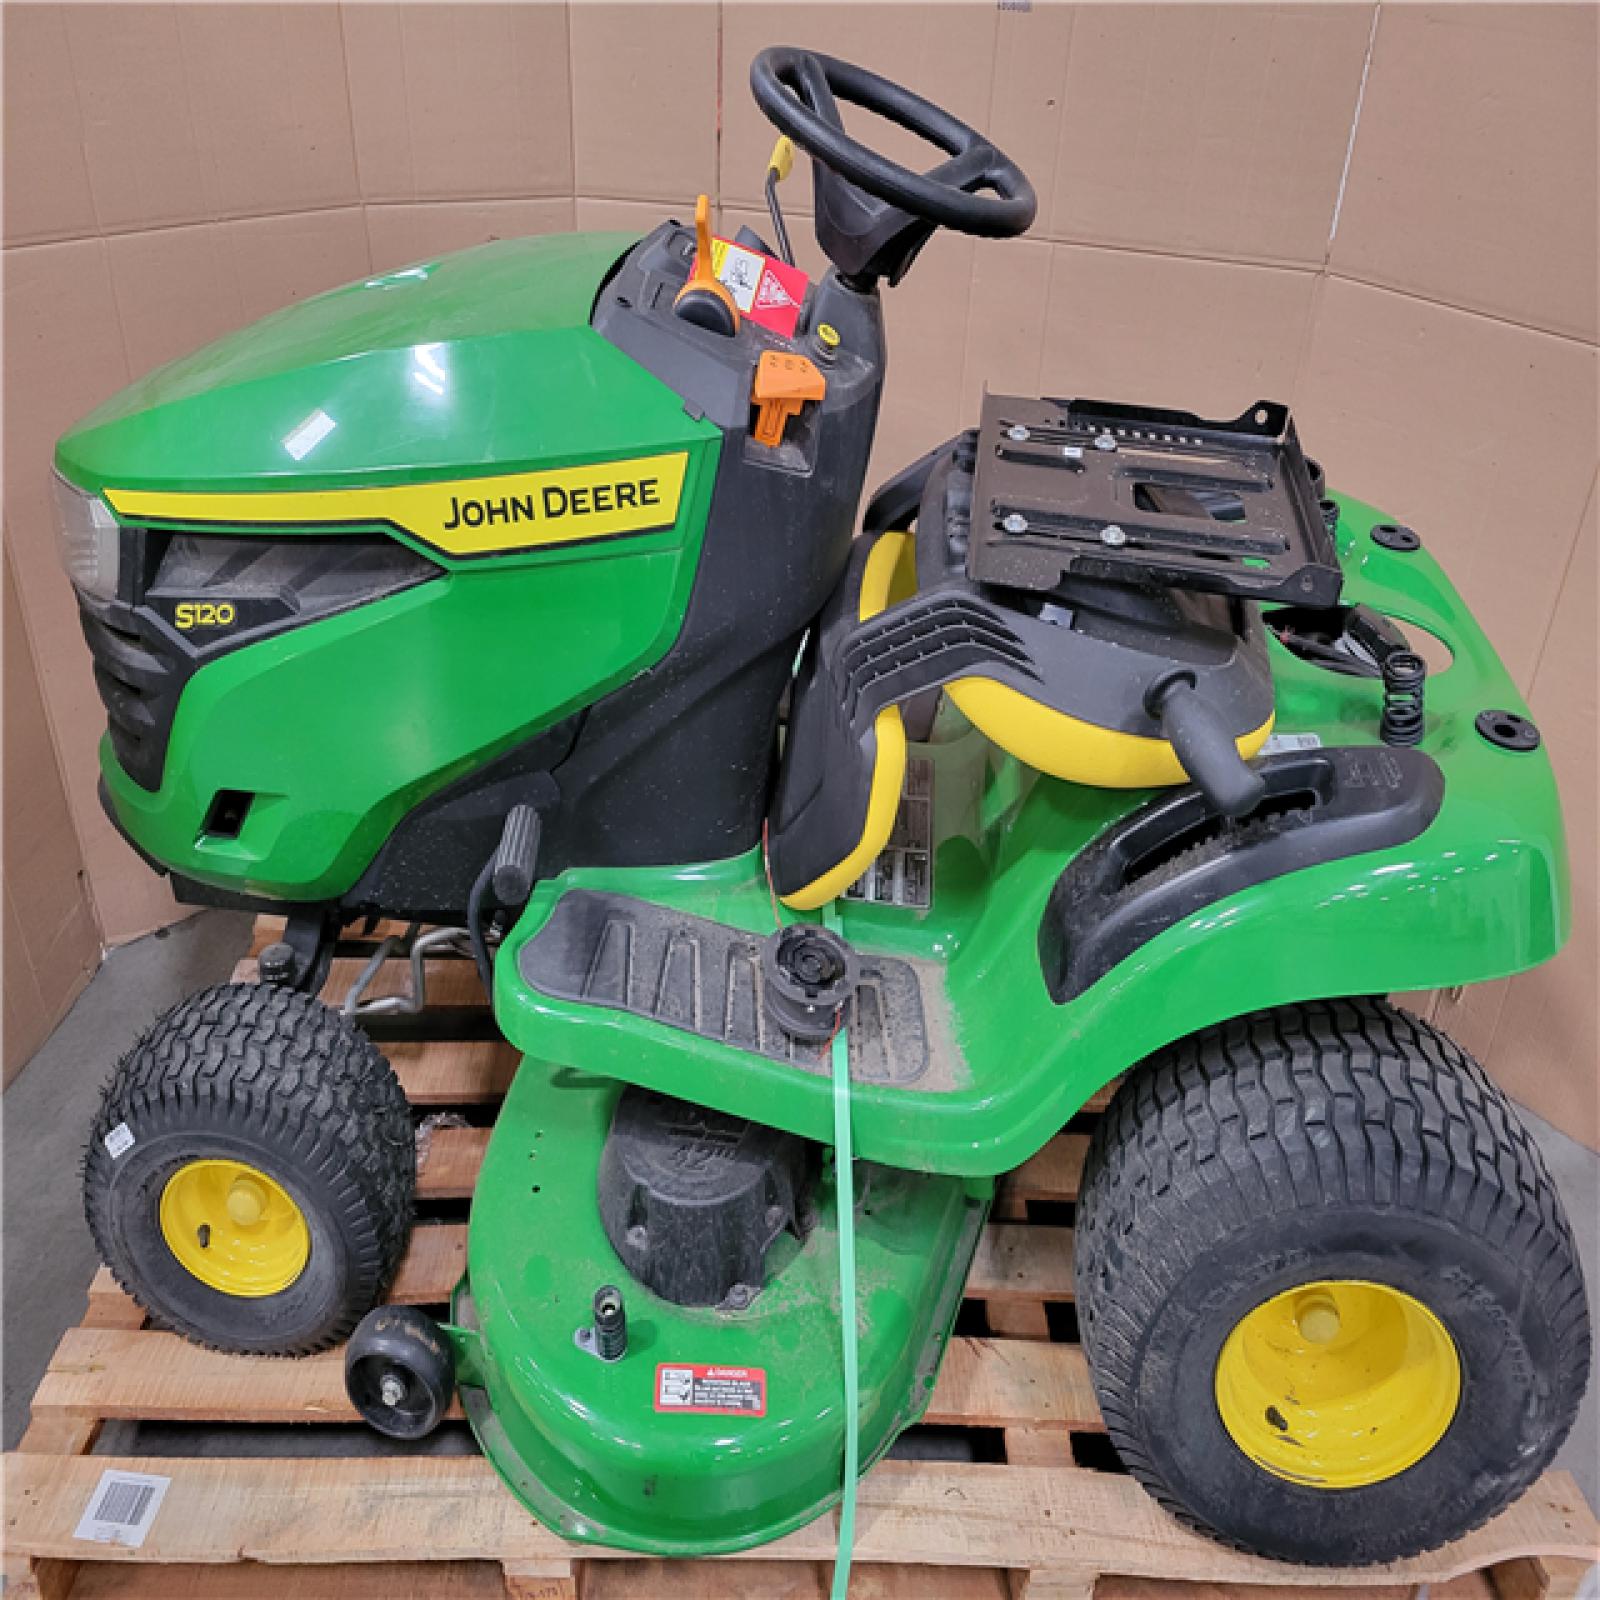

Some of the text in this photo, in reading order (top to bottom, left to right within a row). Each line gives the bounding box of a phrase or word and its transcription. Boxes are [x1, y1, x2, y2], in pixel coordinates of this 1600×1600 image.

[444, 478, 660, 530] JOHN DEERE
[175, 603, 235, 629] S120
